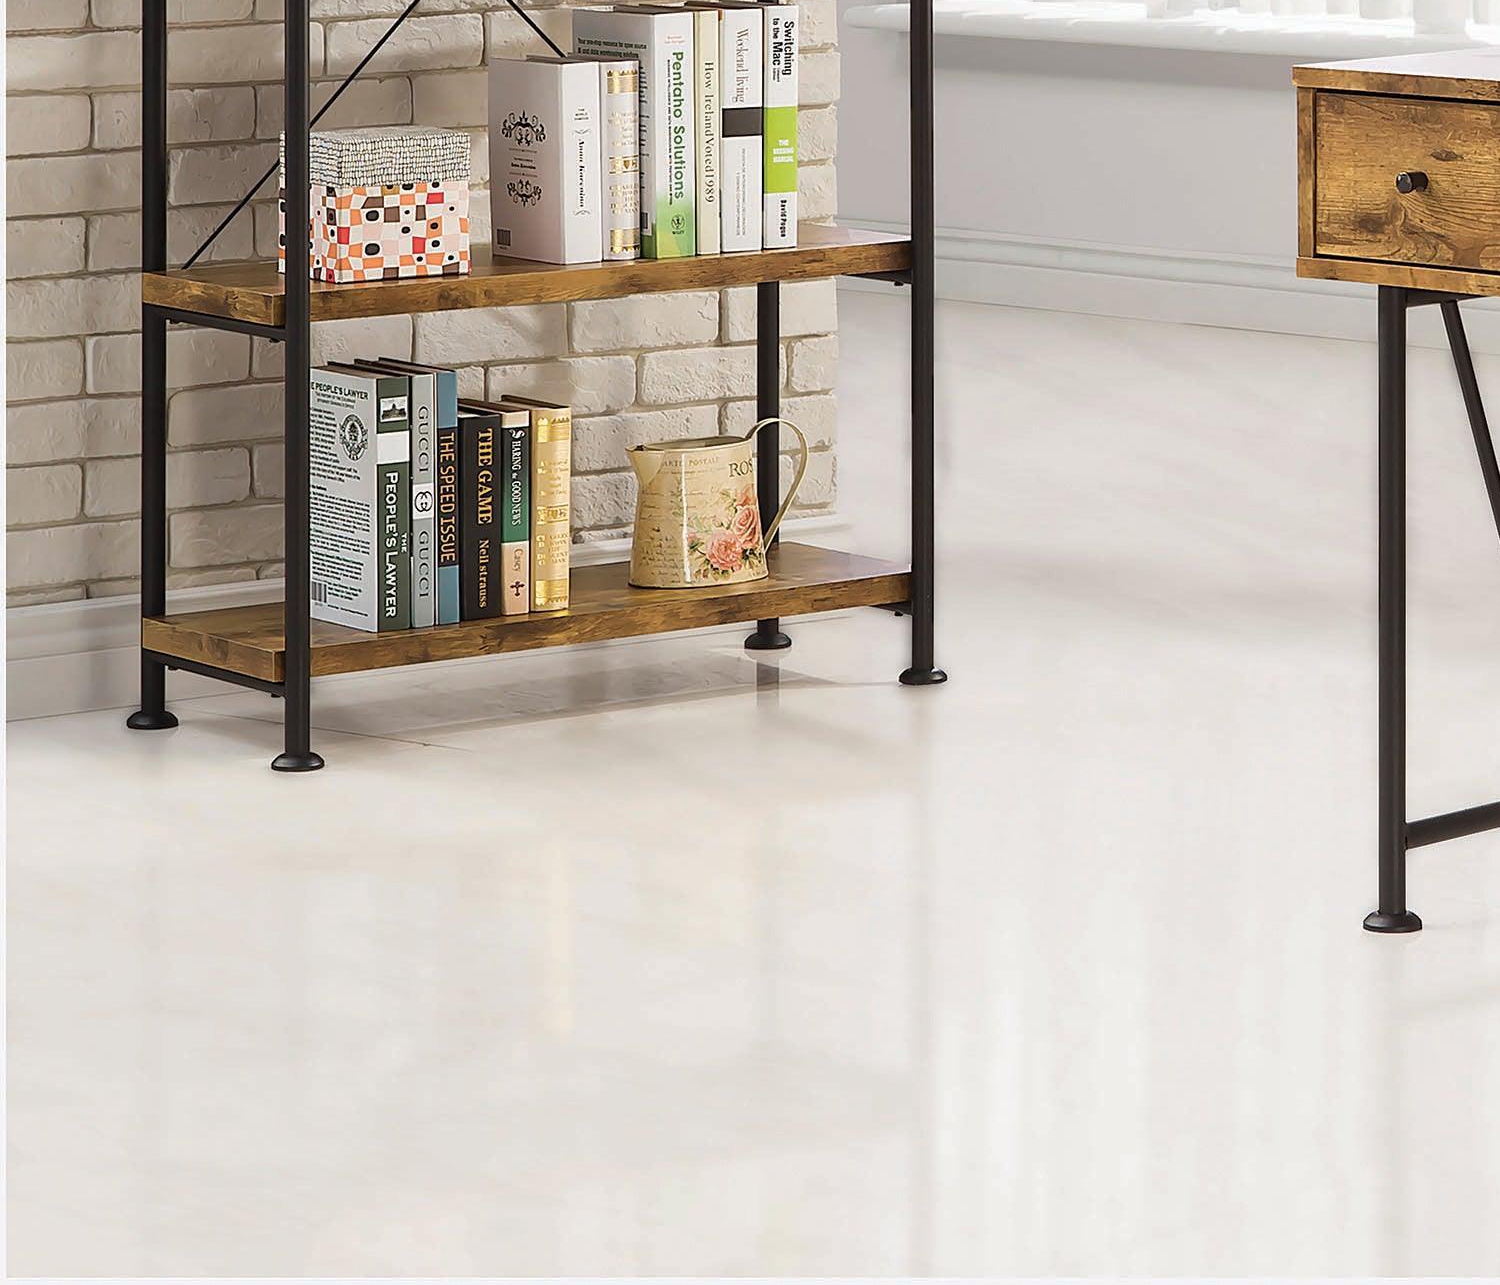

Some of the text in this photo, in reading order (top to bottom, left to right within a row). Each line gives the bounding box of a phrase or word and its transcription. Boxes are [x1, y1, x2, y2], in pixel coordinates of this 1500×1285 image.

[732, 28, 749, 103] Weekend living
[772, 18, 783, 66] to the Mac
[782, 21, 794, 75] Switching
[672, 52, 684, 118] Pentaho
[704, 62, 714, 89] How
[673, 125, 686, 199] Solutions
[344, 388, 368, 400] LAWYER
[418, 406, 429, 472] GUCCI
[440, 432, 455, 563] THE SPEED ISSUE
[478, 428, 493, 524] THE GAME
[512, 481, 521, 503] GOOD
[386, 472, 398, 617] PEOPLE'S LAWYER
[512, 504, 521, 525] NEWS
[419, 531, 429, 597] GUCCI
[479, 539, 489, 608] Neil strauss
